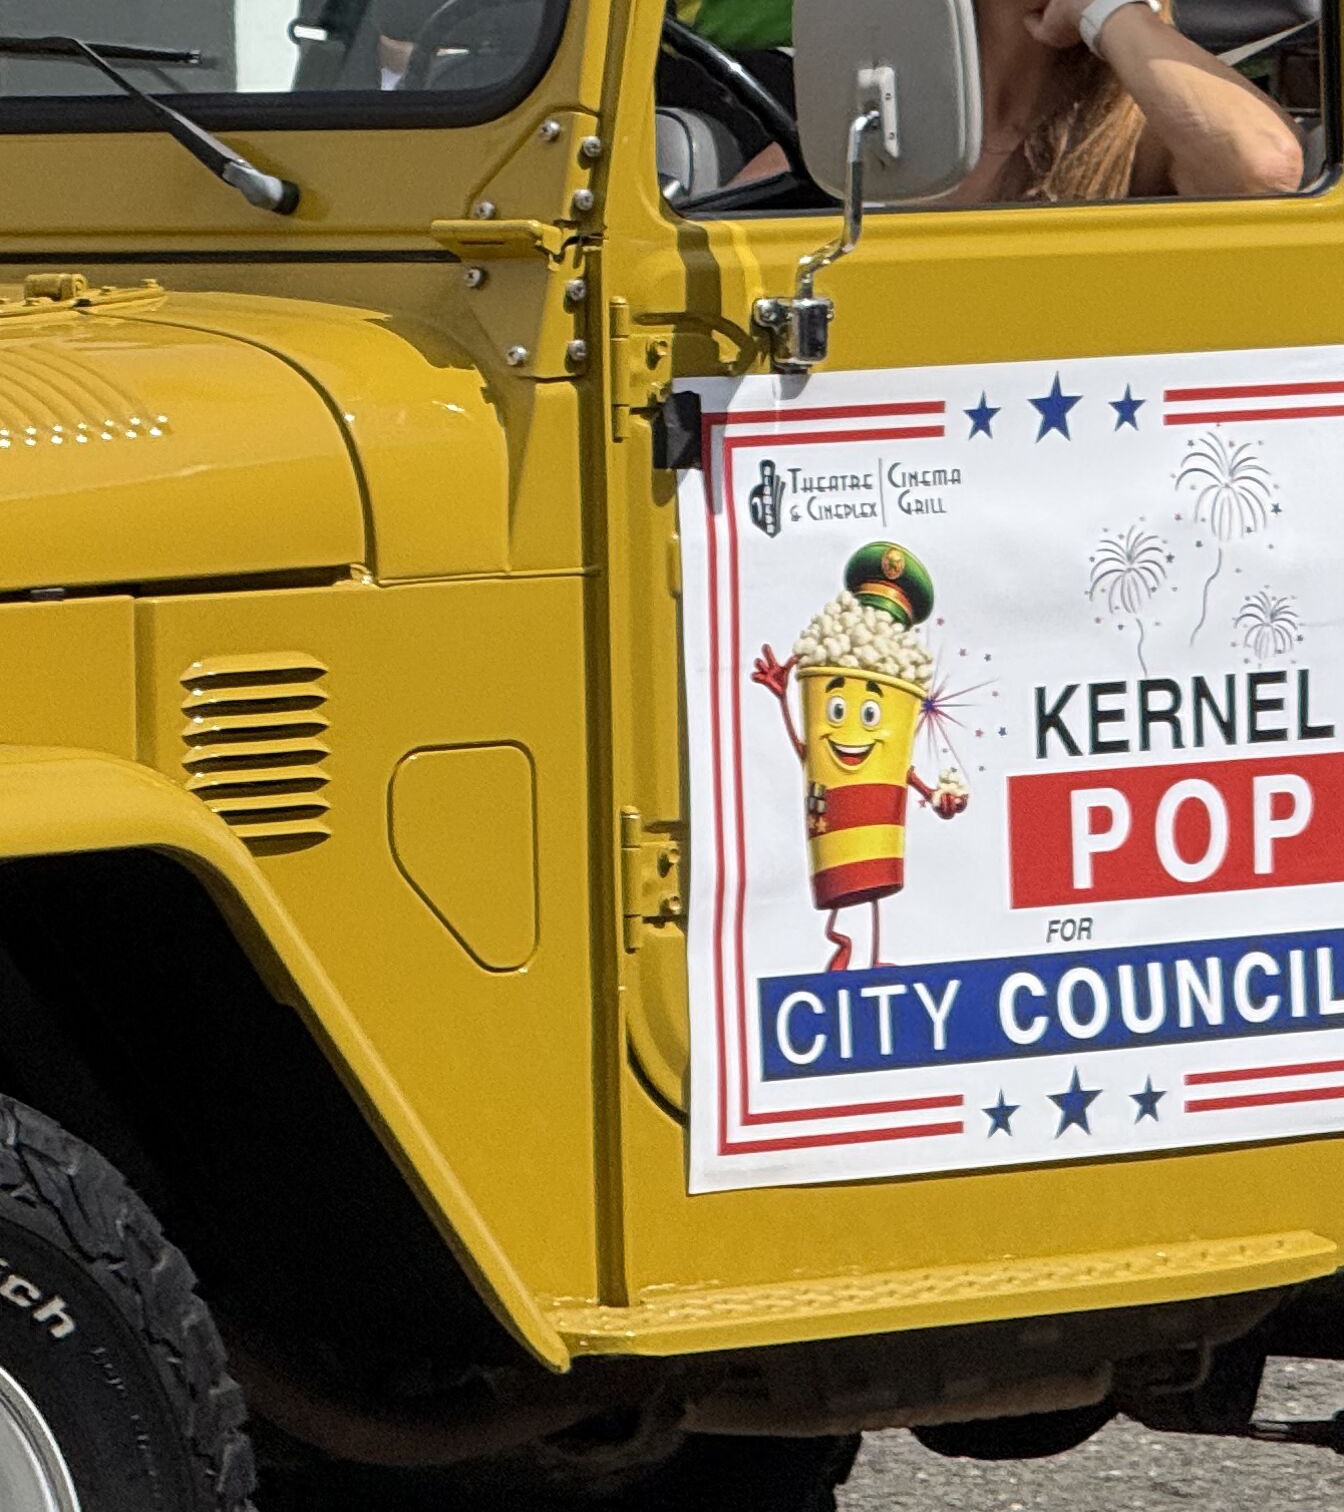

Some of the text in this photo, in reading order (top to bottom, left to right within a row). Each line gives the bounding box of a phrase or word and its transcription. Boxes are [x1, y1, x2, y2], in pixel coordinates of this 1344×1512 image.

[786, 467, 874, 494] THEATRE
[887, 461, 962, 488] CINEMA
[807, 495, 878, 521] CINEPLEX
[897, 489, 948, 515] GRILL
[1033, 668, 1336, 760] KERNEL
[1068, 773, 1315, 890] POP
[1045, 917, 1093, 944] FOR
[774, 978, 962, 1067] CITY
